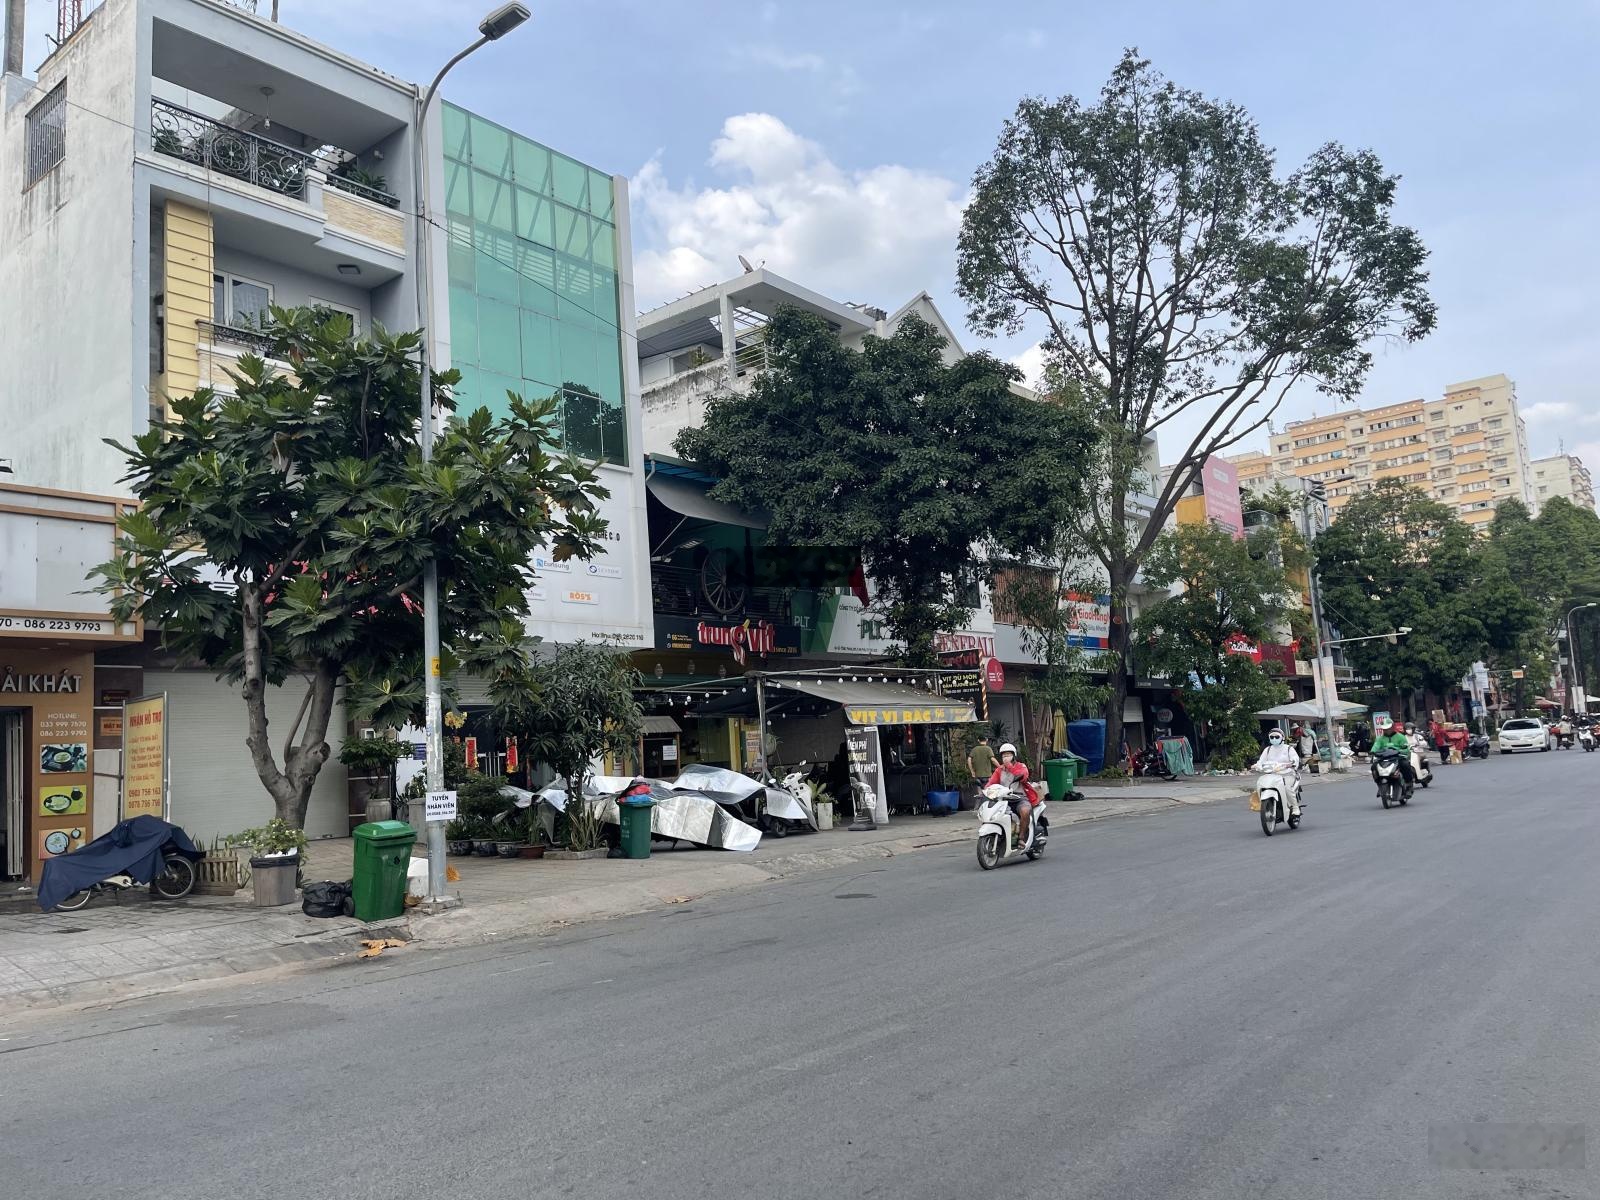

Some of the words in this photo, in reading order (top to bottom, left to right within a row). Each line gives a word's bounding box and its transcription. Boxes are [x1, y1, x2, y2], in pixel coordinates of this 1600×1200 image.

[24, 619, 46, 629] 086
[49, 621, 71, 630] 223
[74, 622, 101, 631] 9793
[793, 616, 809, 628] PLT
[859, 619, 882, 640] PLT
[29, 669, 82, 693] KHÁT
[432, 793, 449, 802] TUYỂN
